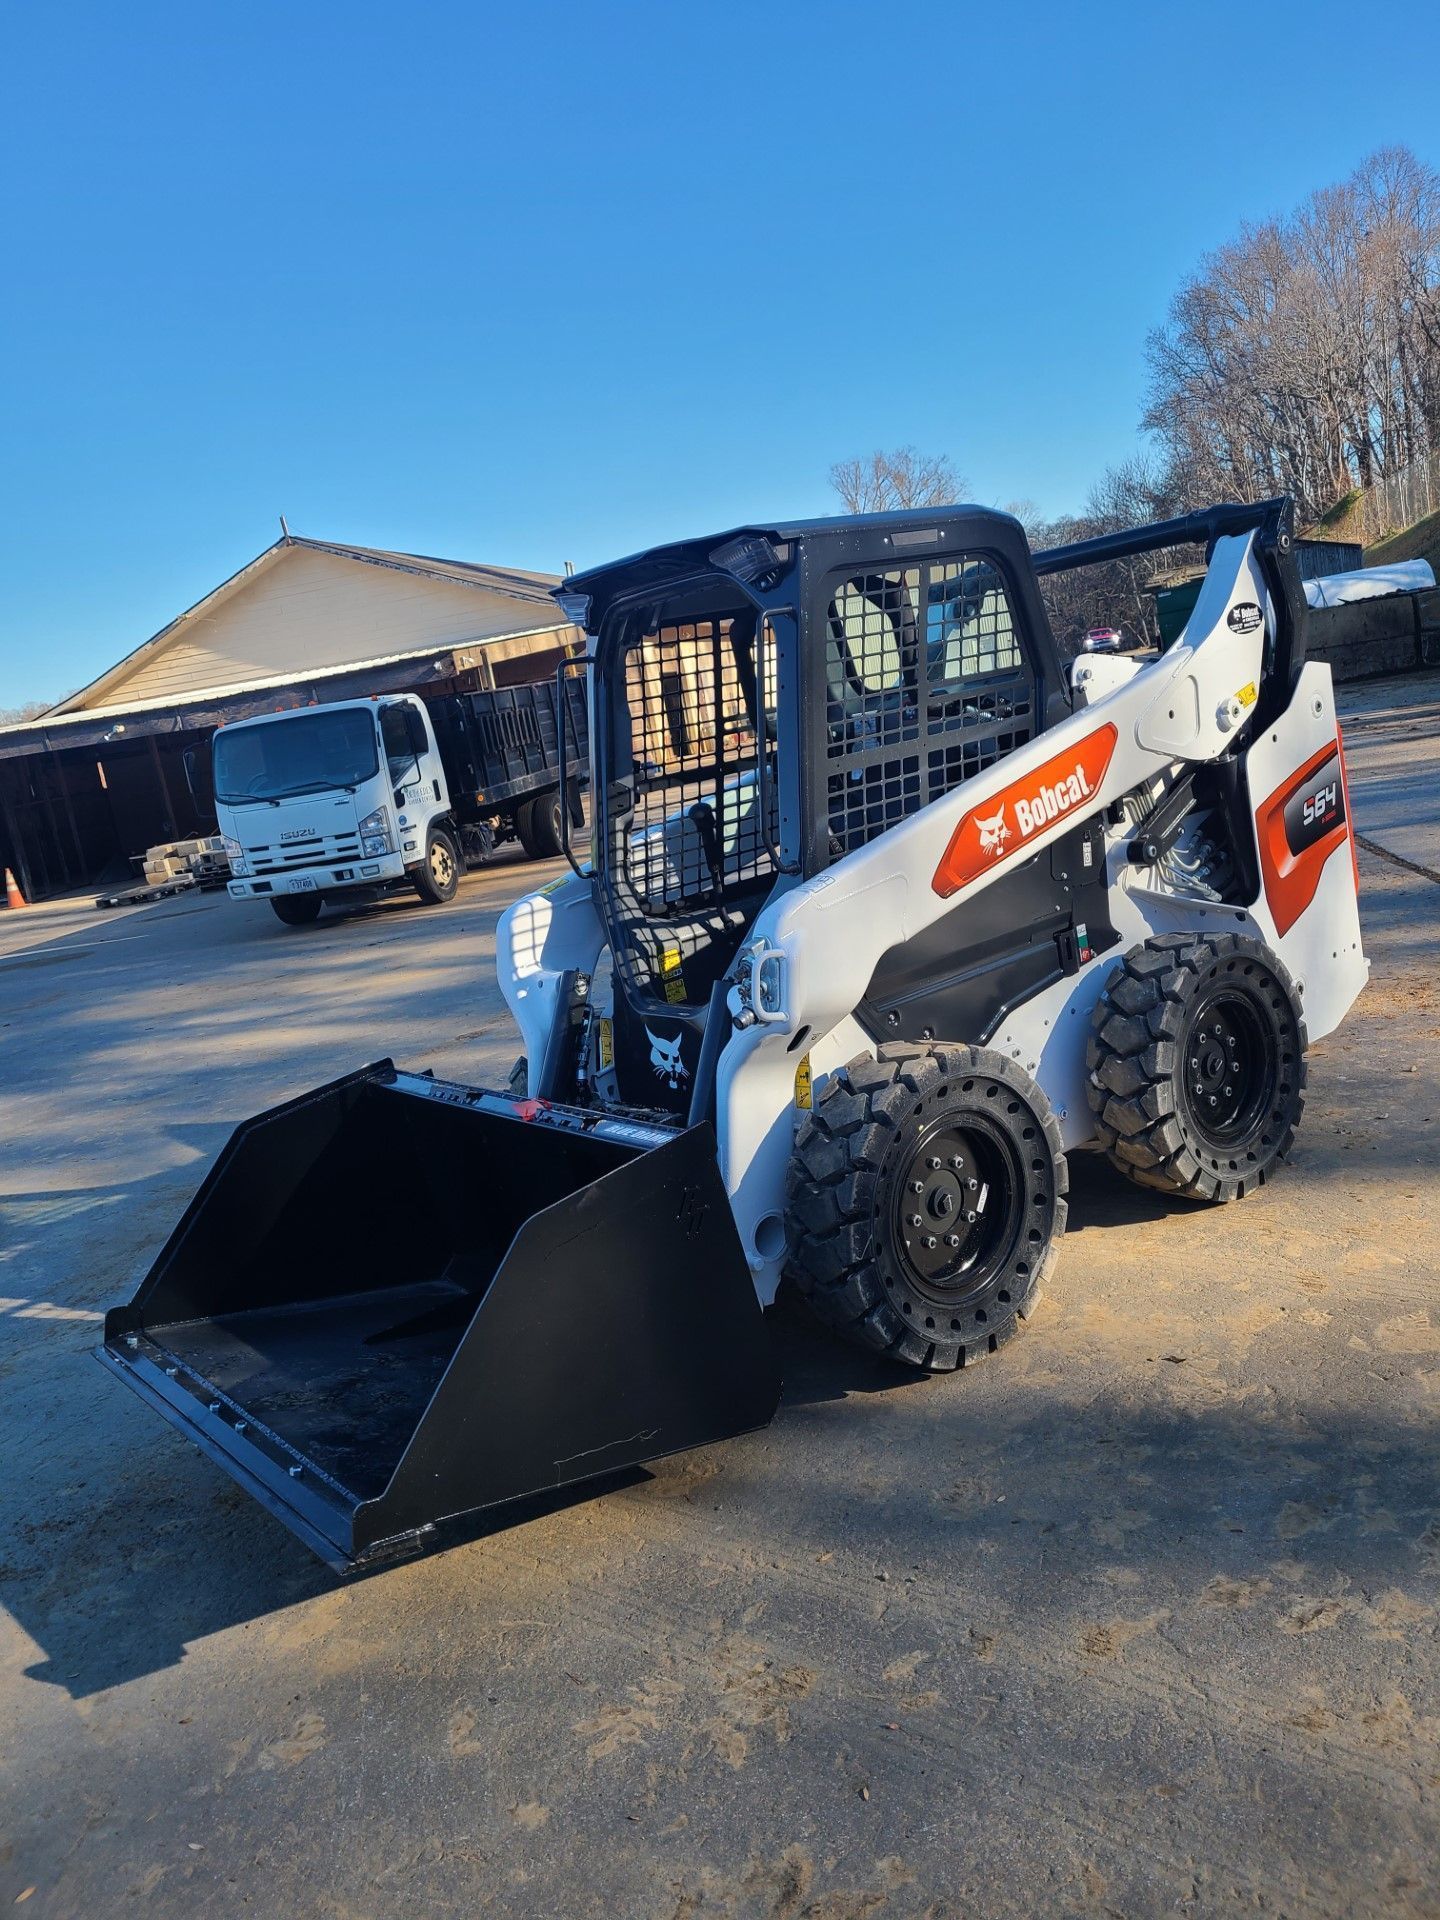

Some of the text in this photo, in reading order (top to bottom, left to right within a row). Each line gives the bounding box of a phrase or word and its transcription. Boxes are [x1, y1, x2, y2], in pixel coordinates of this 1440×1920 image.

[1014, 763, 1090, 837] Bobcat
[1303, 782, 1336, 826] S64
[280, 828, 316, 839] ISUZU
[604, 1124, 637, 1136] BLUE
